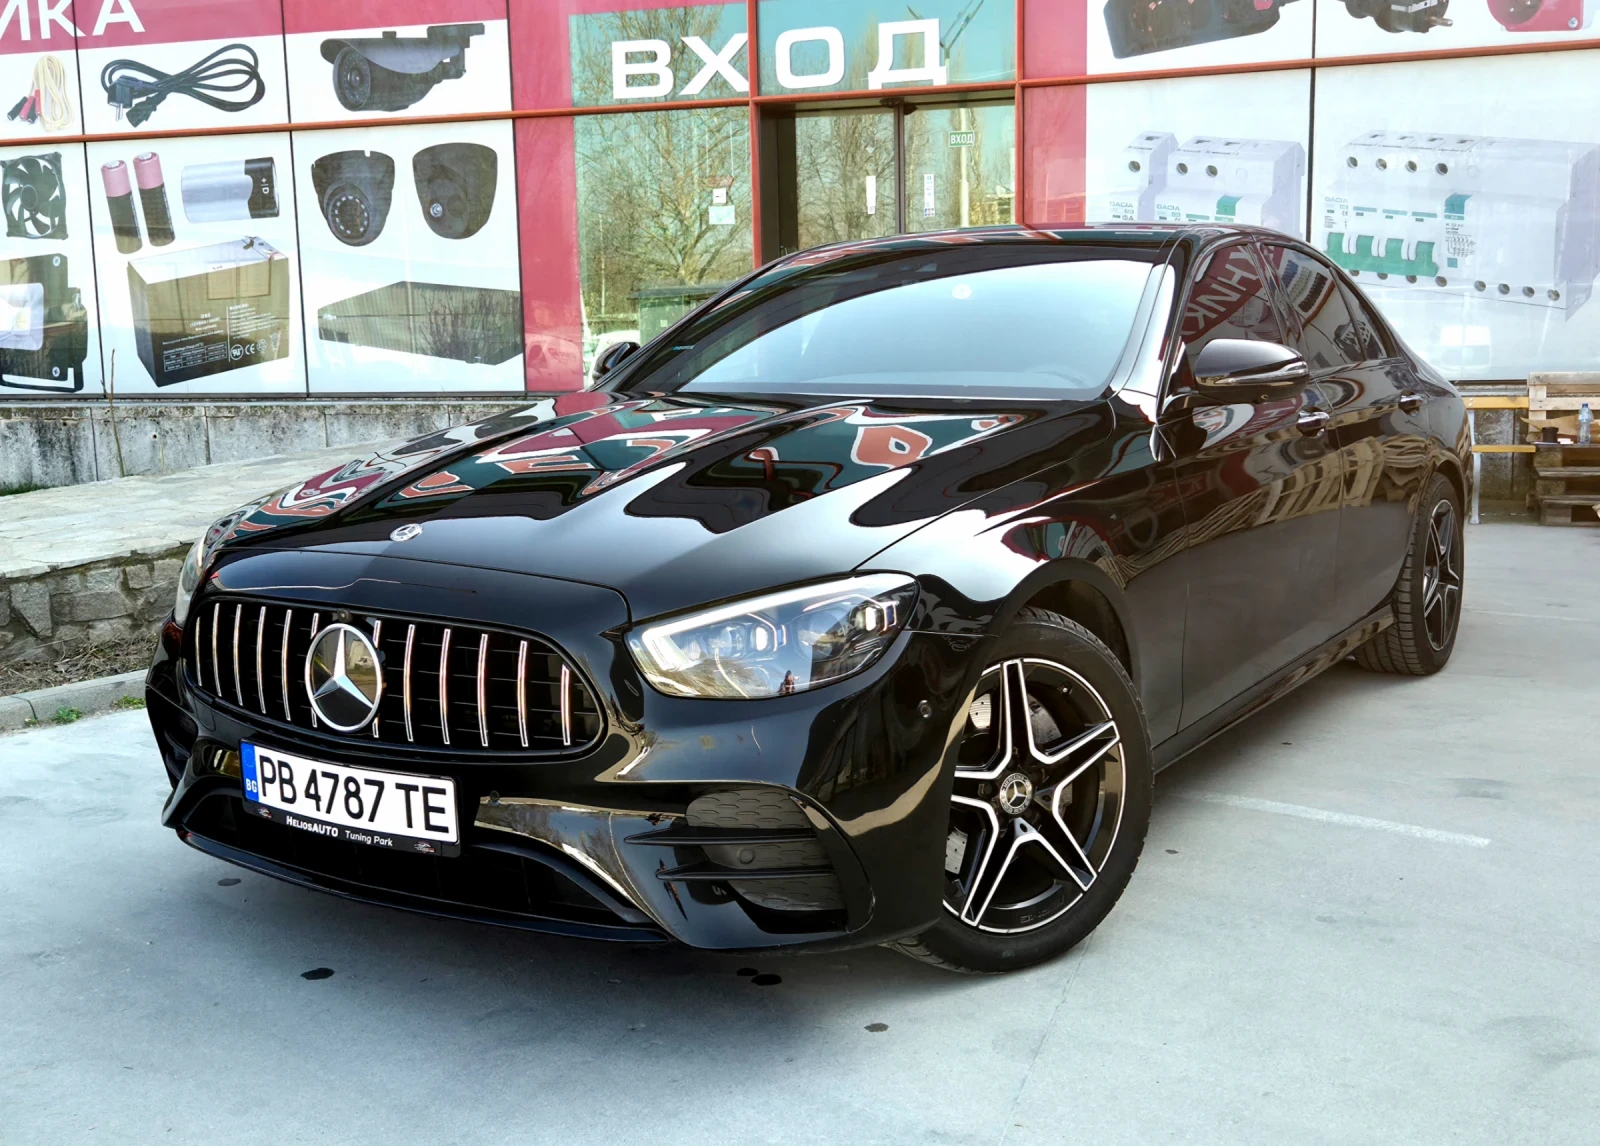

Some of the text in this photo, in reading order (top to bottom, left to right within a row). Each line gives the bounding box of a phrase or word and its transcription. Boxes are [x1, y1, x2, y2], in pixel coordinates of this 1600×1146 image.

[611, 18, 947, 99] ВХОД
[950, 133, 974, 144] ВХОД
[245, 778, 258, 793] BG
[259, 755, 450, 834] PB 4787 TE
[345, 830, 372, 844] Tuning
[373, 835, 393, 847] Park
